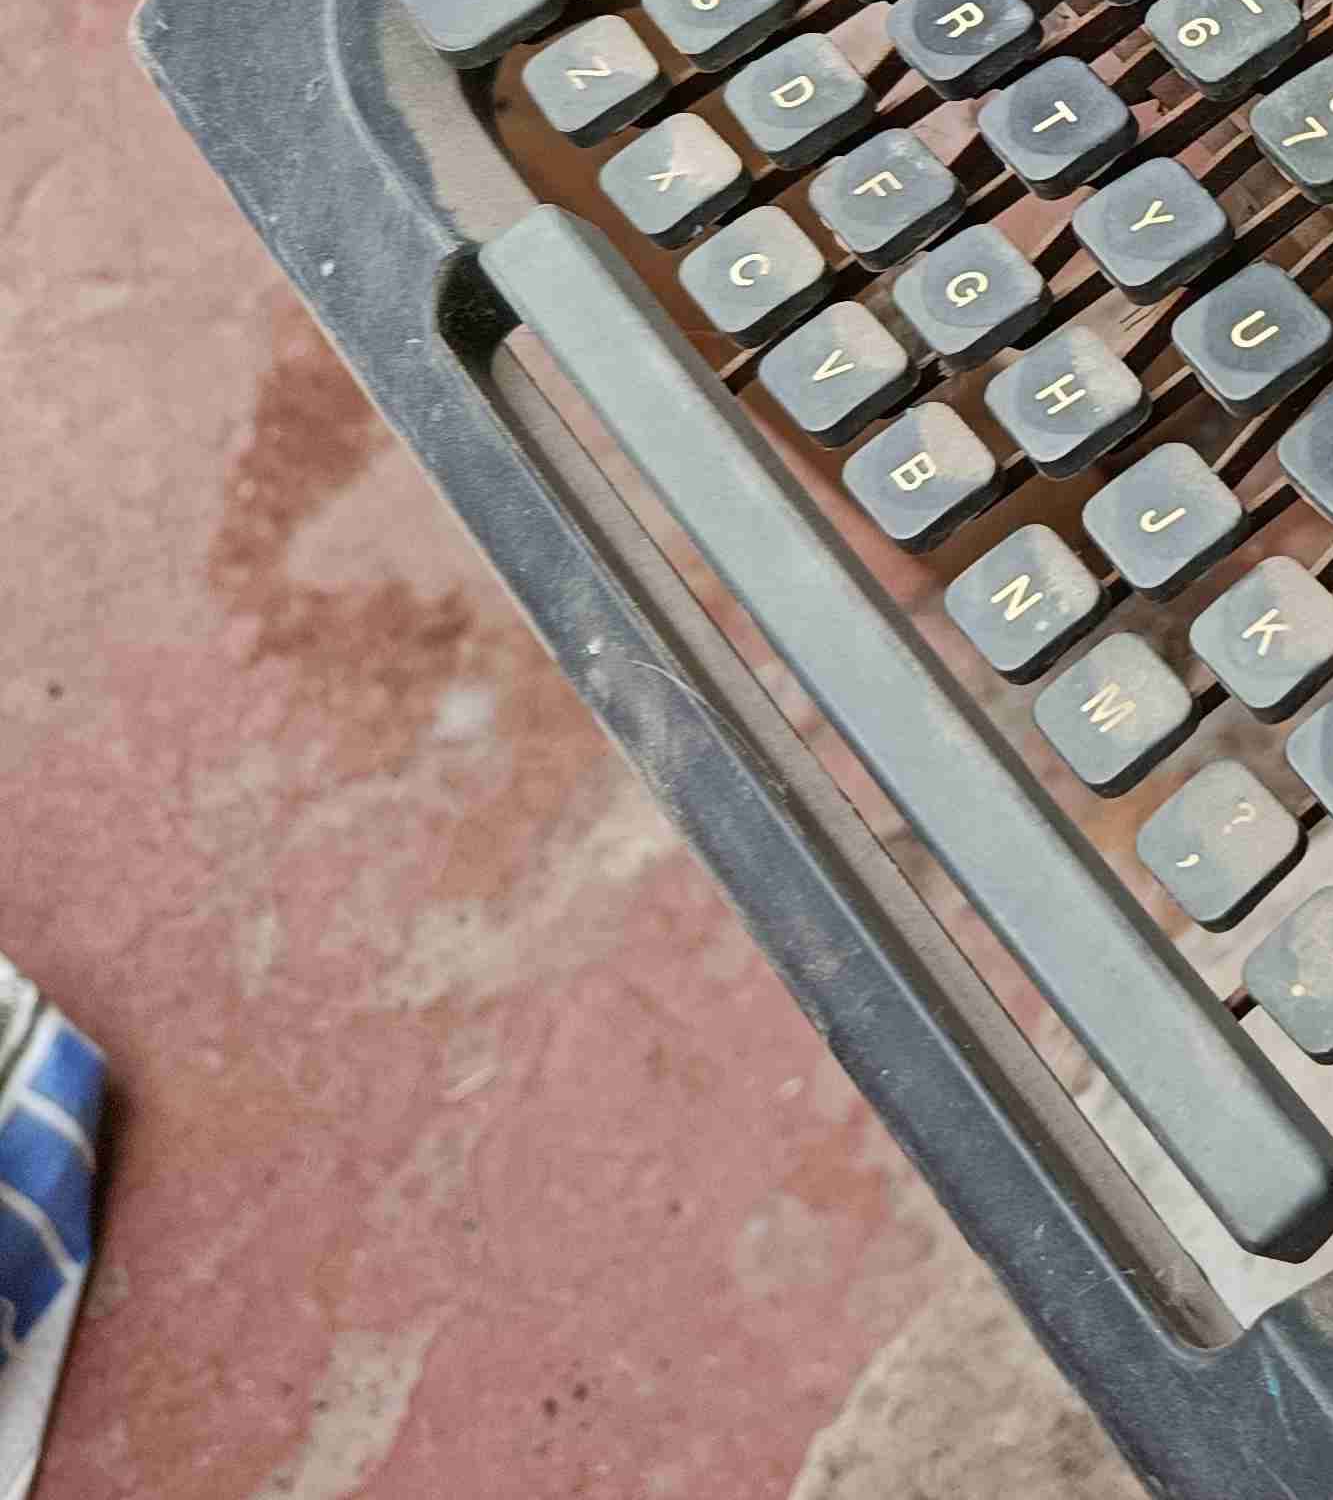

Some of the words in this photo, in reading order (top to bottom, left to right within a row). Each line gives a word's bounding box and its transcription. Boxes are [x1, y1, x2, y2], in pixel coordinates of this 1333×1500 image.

[935, 2, 985, 38] R
[1177, 17, 1220, 47] 6
[565, 55, 612, 91] Z
[770, 75, 814, 108] D
[1032, 100, 1078, 133] T
[1282, 116, 1329, 148] 7
[852, 171, 903, 197] F
[1130, 200, 1174, 231] Y
[729, 253, 771, 286] C
[946, 271, 988, 307] G
[1231, 310, 1279, 348] U
[812, 349, 855, 381] V
[1034, 373, 1087, 415] H
[890, 451, 939, 491] B
[1140, 507, 1186, 533] J
[990, 574, 1043, 621] N
[1242, 608, 1292, 656] K
[1080, 683, 1137, 733] M
[1223, 802, 1257, 834] ?
